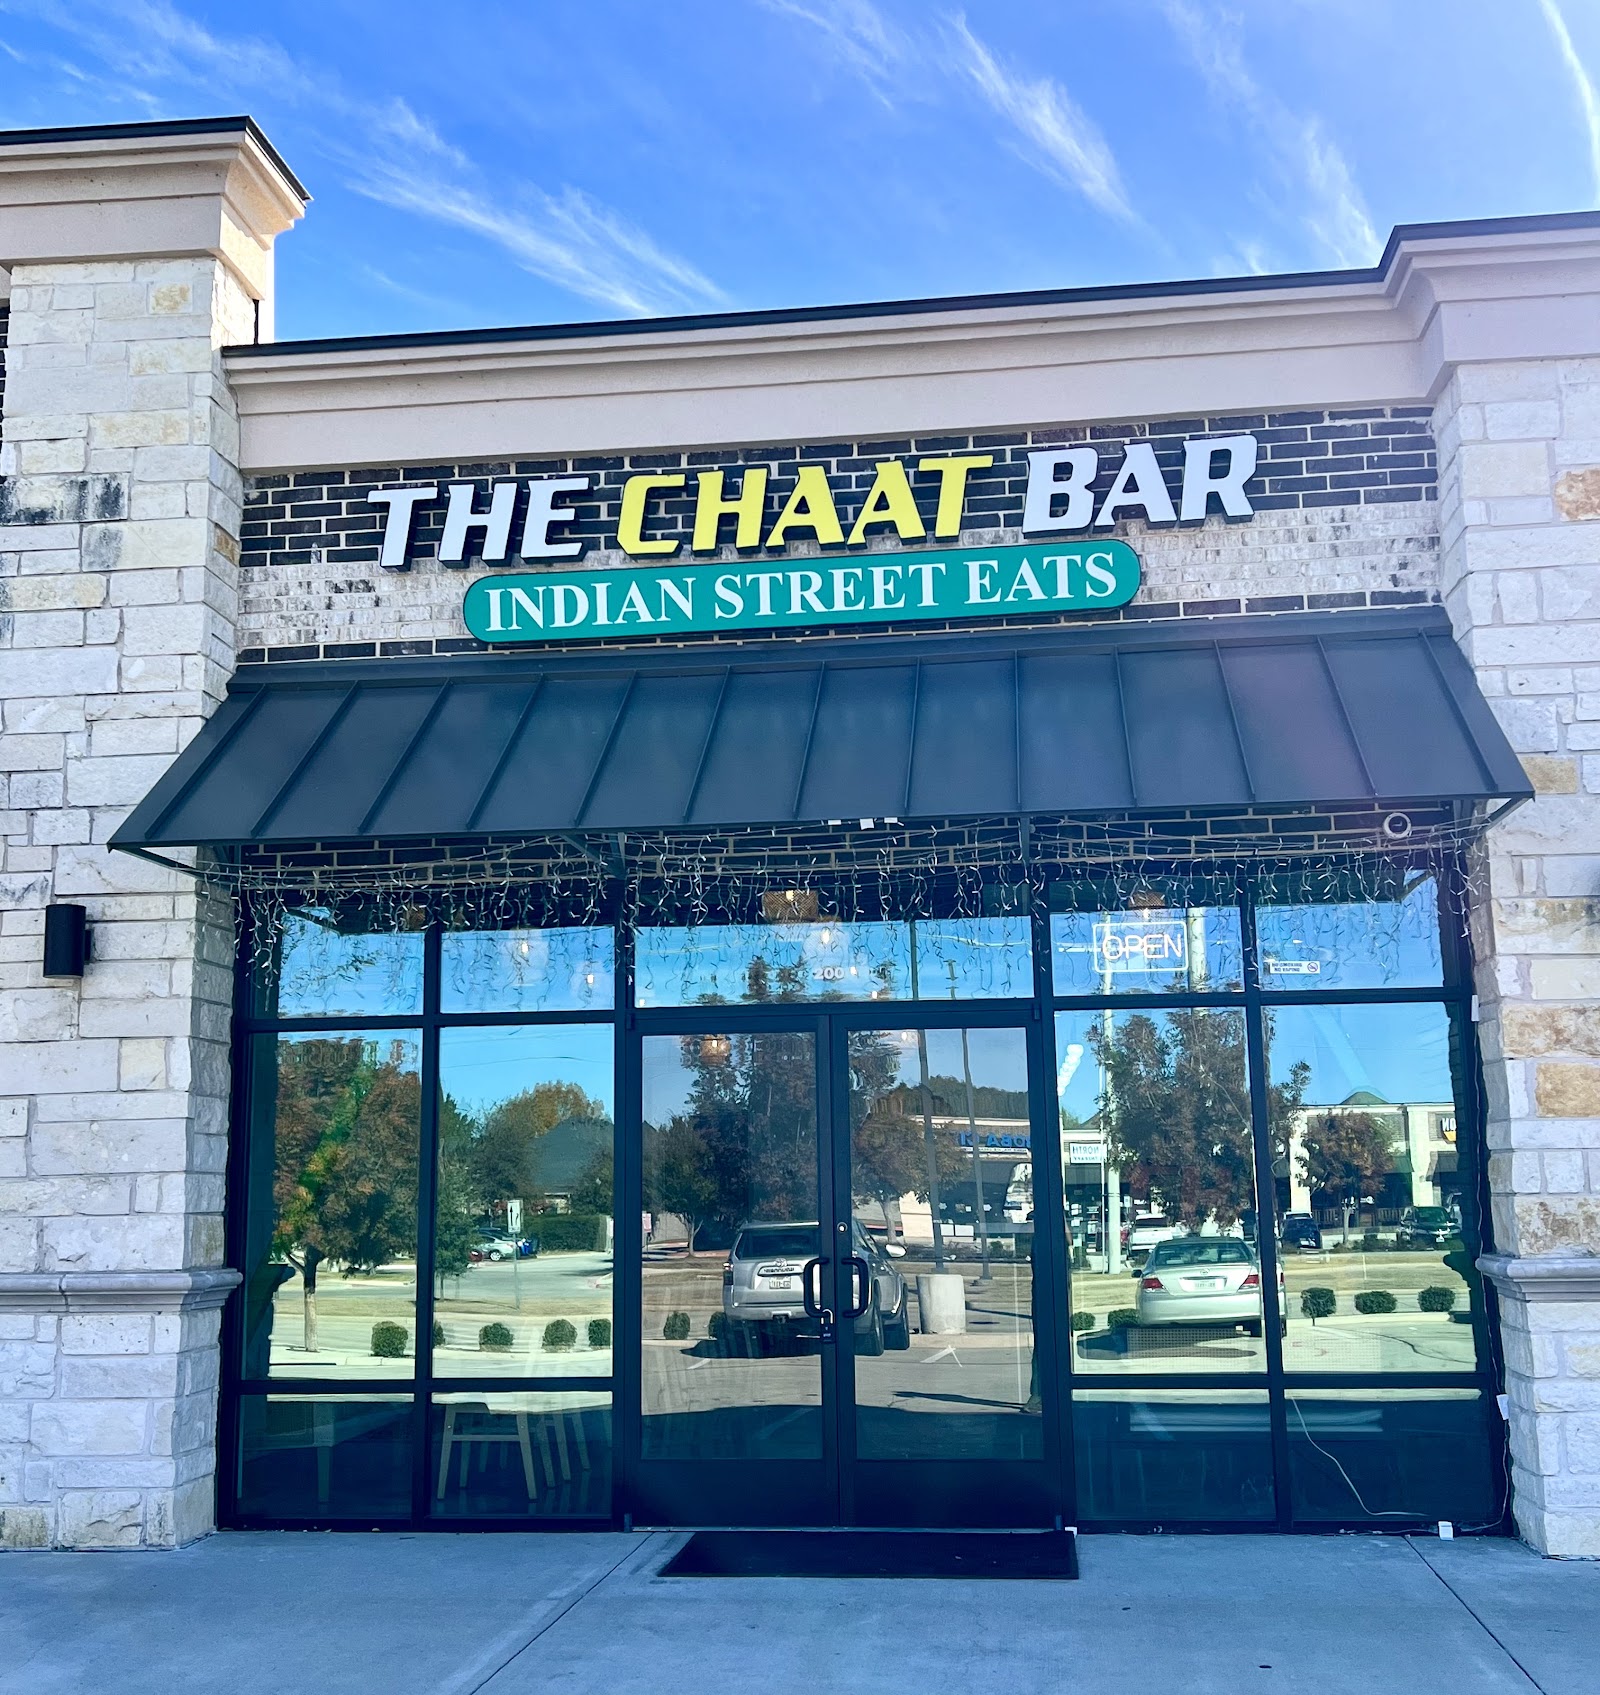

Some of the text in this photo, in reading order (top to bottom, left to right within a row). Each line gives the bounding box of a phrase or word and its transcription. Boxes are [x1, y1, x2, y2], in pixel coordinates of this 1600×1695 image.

[367, 433, 1258, 568] THE CHAAT BAR
[485, 551, 1117, 632] INDIAN STREET EATS
[812, 967, 845, 980] 200
[1102, 933, 1182, 960] OPEN
